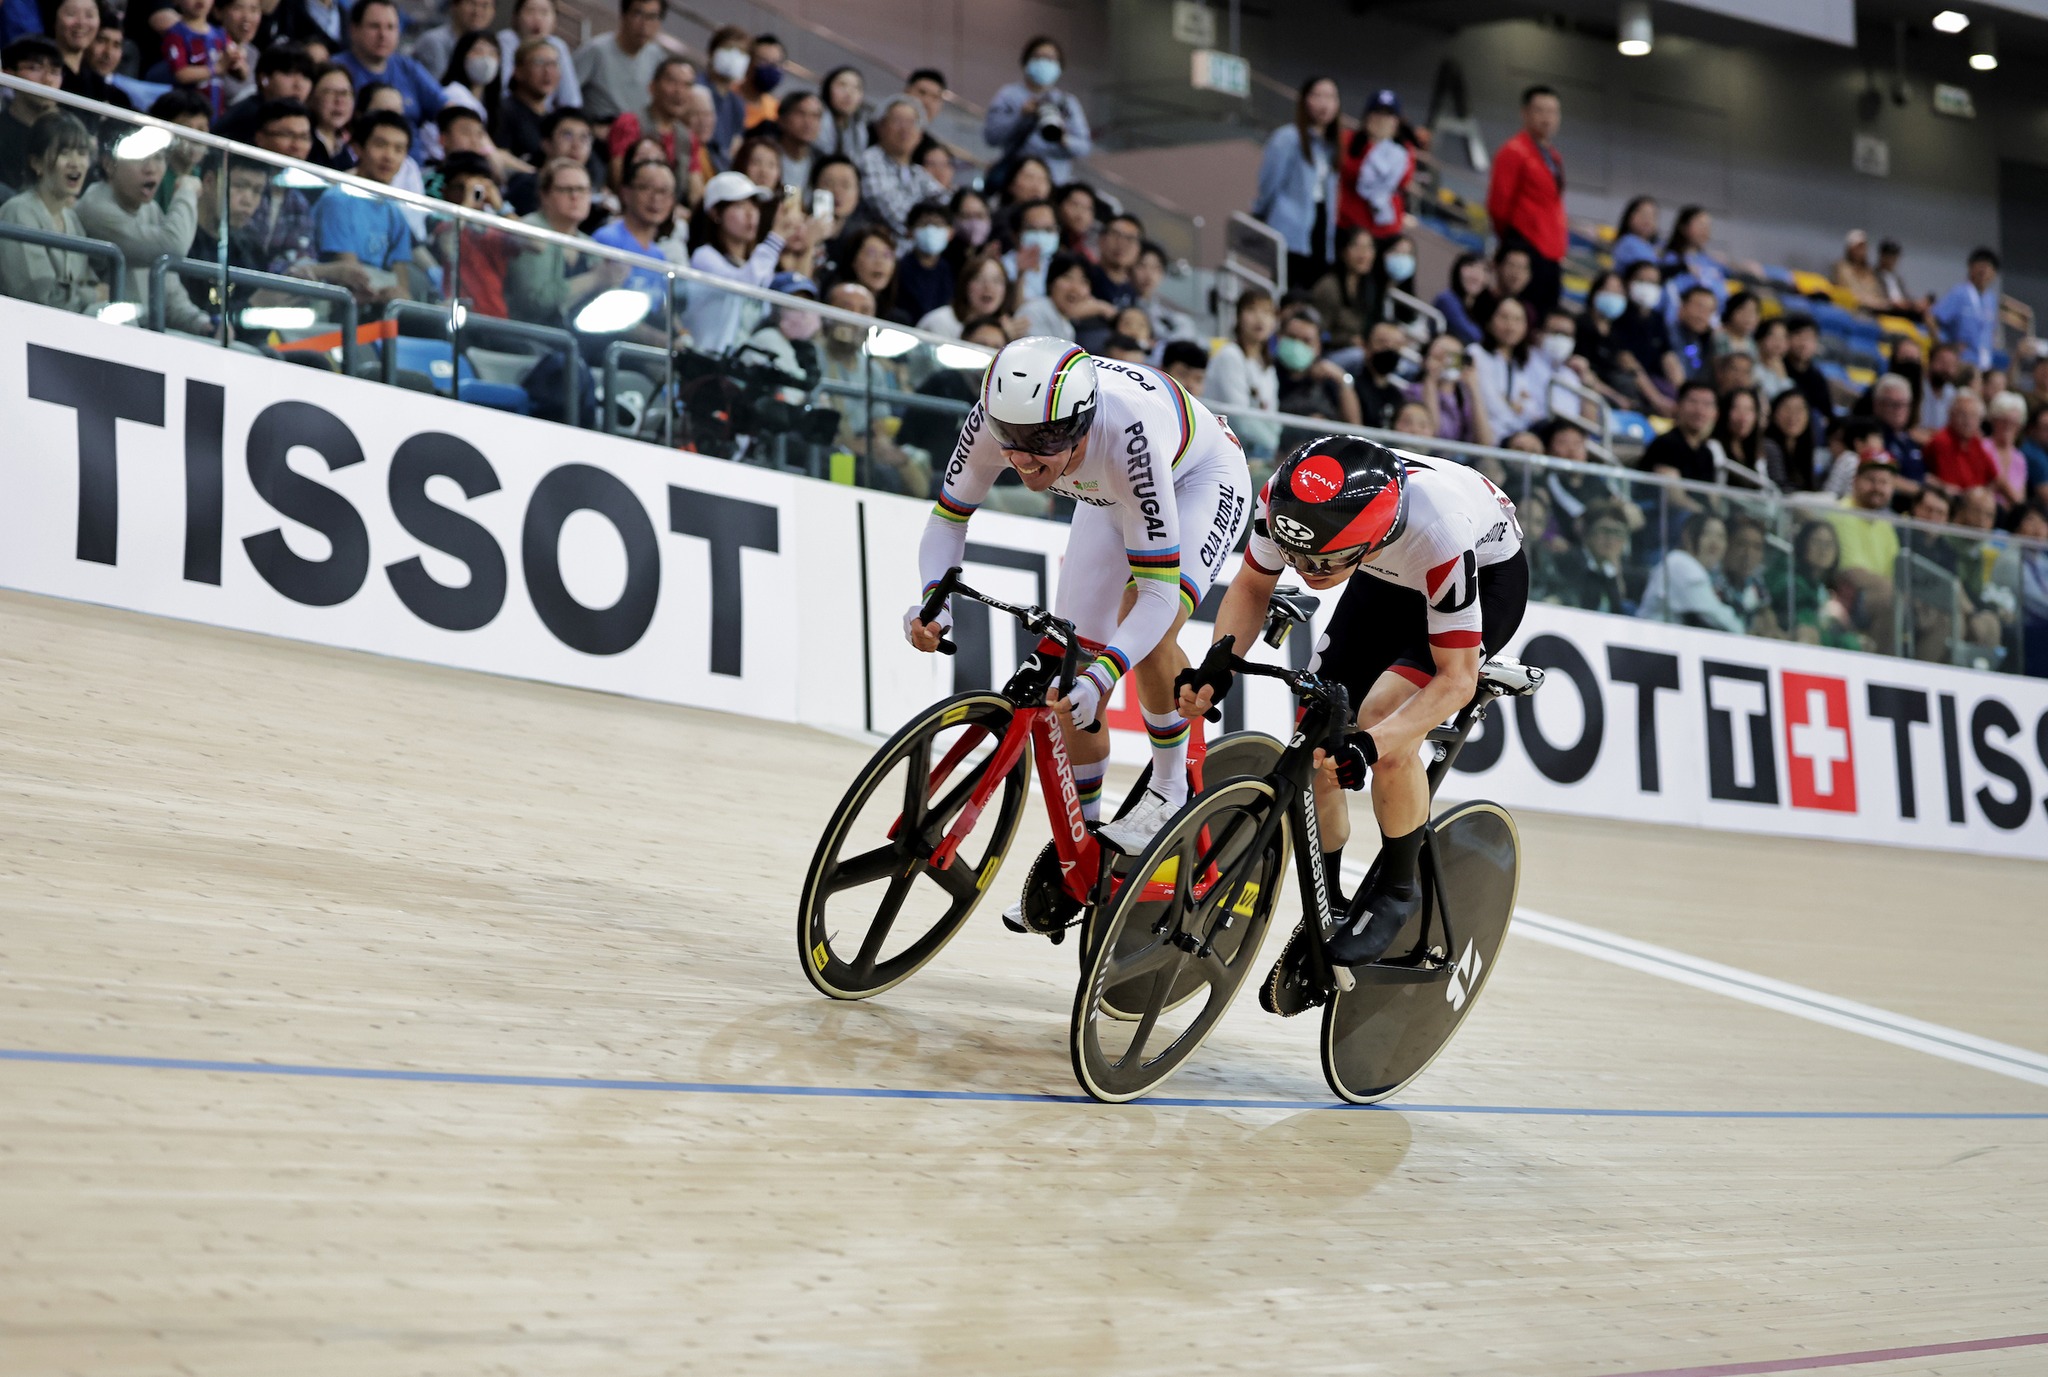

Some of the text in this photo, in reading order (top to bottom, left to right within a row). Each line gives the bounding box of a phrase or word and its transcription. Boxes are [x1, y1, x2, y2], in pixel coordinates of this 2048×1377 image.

[1093, 359, 1157, 392] PORTU
[946, 402, 984, 486] PORTUGA
[1125, 421, 1167, 541] PORTUGAL
[1298, 469, 1337, 490] JAPAN
[27, 342, 780, 678] TISSOT
[1200, 484, 1234, 568] CAJA RURAL
[1274, 526, 1312, 549] Kabuto
[1045, 711, 1085, 843] PINARELLO
[1867, 683, 2048, 829] TIS
[1303, 784, 1333, 930] BRIDGESTONE
